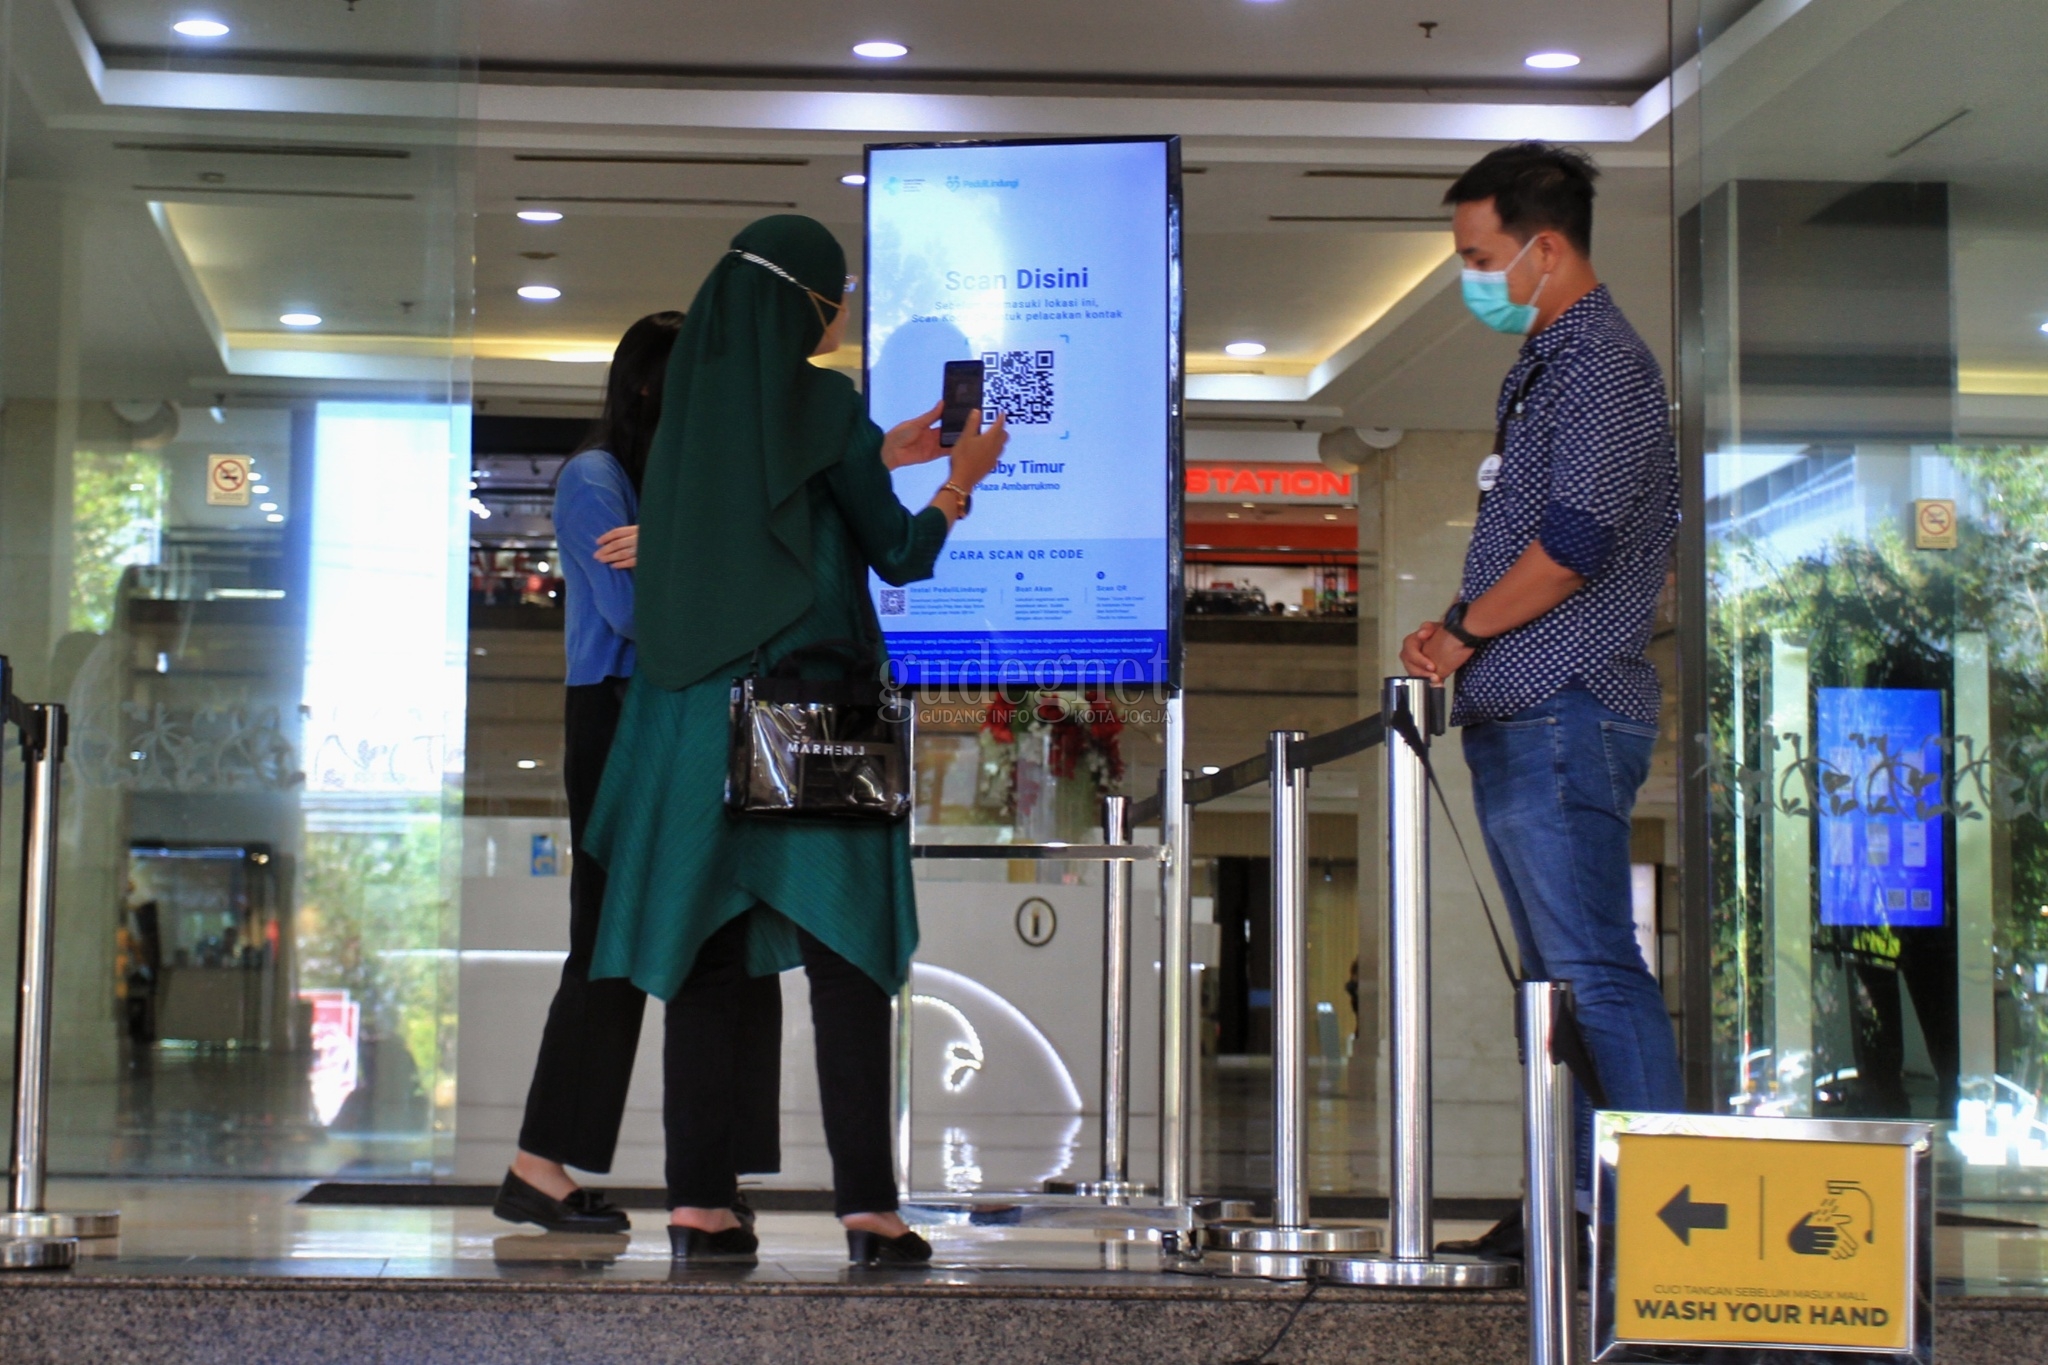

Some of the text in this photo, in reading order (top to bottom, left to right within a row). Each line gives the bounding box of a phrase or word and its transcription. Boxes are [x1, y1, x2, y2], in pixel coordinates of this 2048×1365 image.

[944, 267, 1089, 291] Scan Disini
[1044, 298, 1078, 308] lokasi
[1025, 311, 1082, 322] pelacakan
[1085, 310, 1124, 320] kontak
[1018, 459, 1066, 474] Timur
[1000, 481, 1061, 491] Ambarrukmo
[1184, 467, 1351, 497] STATION
[949, 549, 1085, 560] CARA SCAN QR CODE
[1683, 1285, 1733, 1297] TANGAN
[1734, 1287, 1791, 1299] SEBELUM
[1634, 1299, 1890, 1328] WASH YOUR HAND
